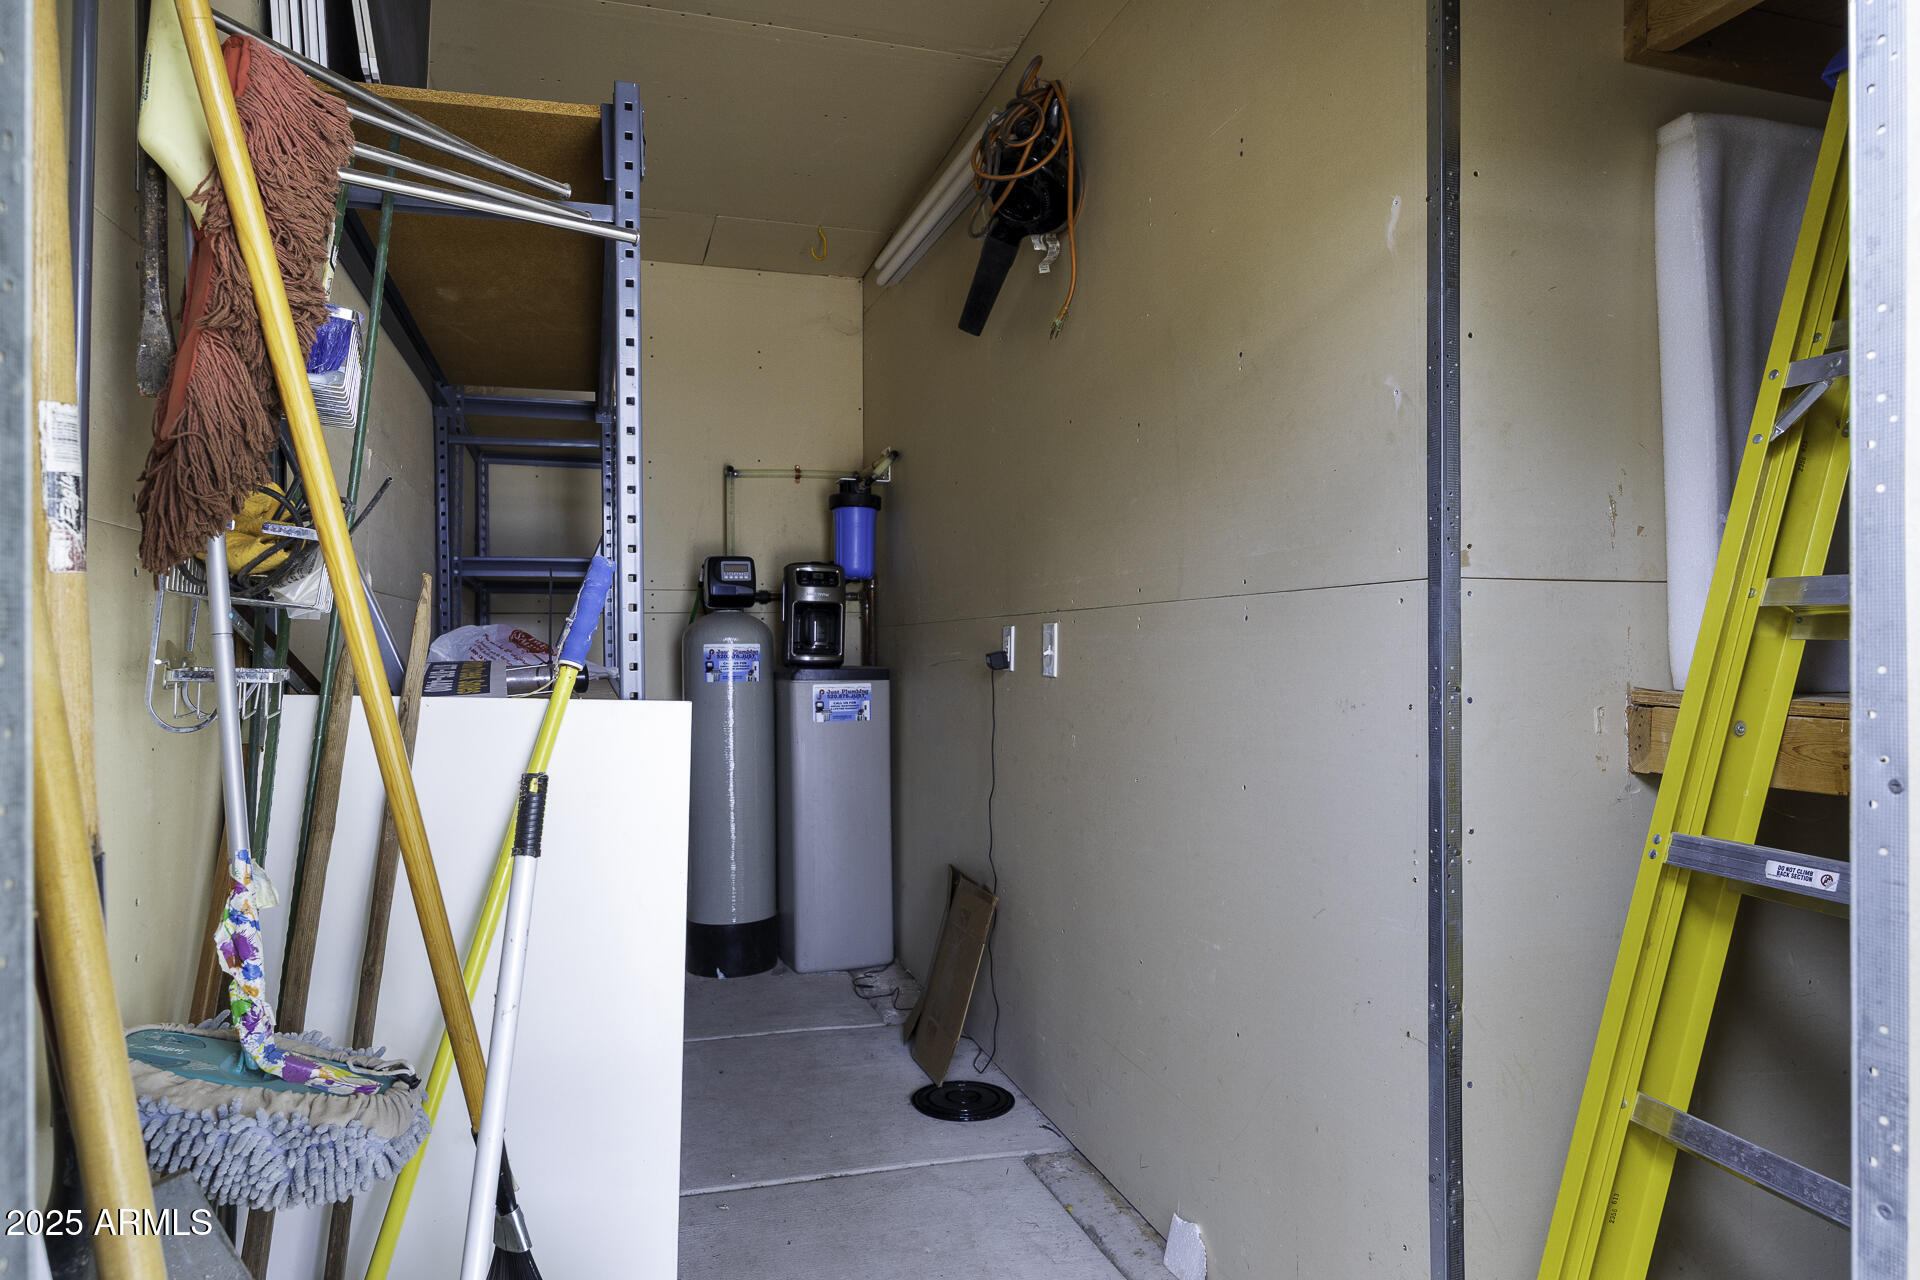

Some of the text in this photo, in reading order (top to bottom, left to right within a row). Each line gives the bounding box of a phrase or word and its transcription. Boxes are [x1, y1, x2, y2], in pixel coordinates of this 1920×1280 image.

[1776, 870, 1790, 878] BACK
[1790, 872, 1813, 882] SECTION
[1796, 868, 1814, 877] CLIMB
